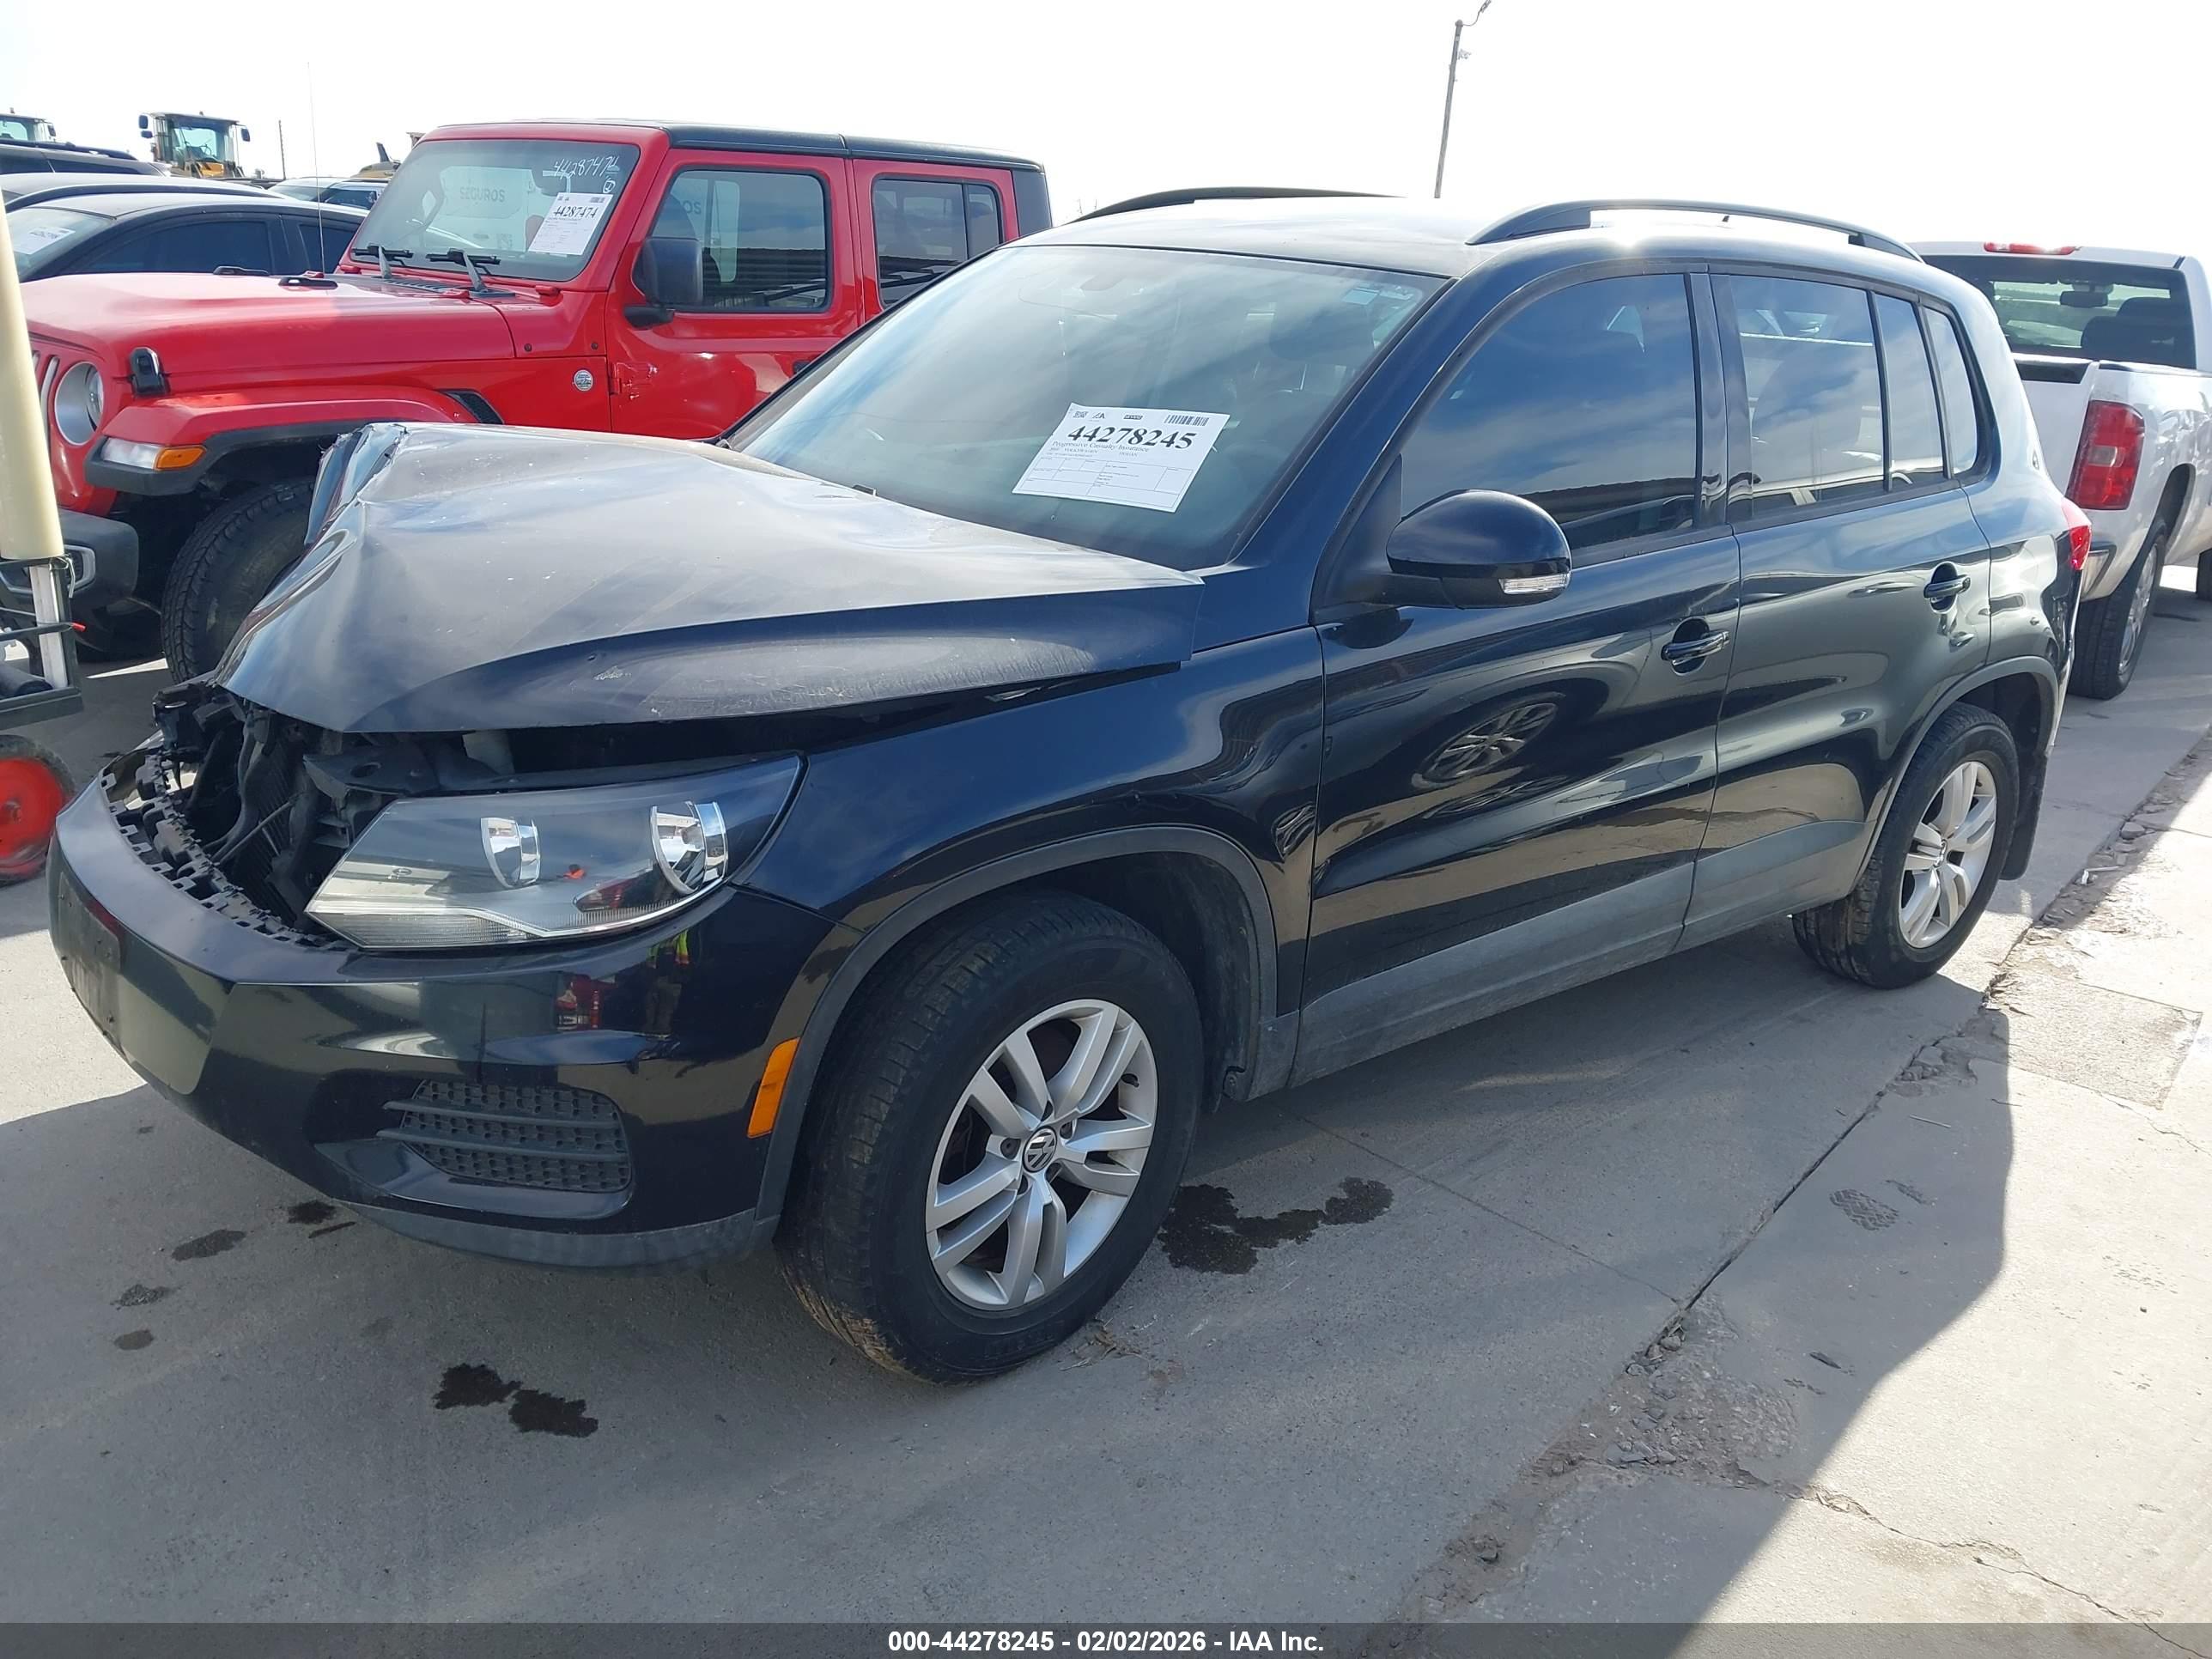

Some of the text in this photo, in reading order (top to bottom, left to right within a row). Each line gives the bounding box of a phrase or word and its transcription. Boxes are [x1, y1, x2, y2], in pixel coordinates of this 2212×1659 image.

[554, 155, 619, 179] 44287474
[553, 205, 599, 218] 44287474
[1067, 425, 1198, 449] 44278245
[1117, 444, 1151, 453] Insurance
